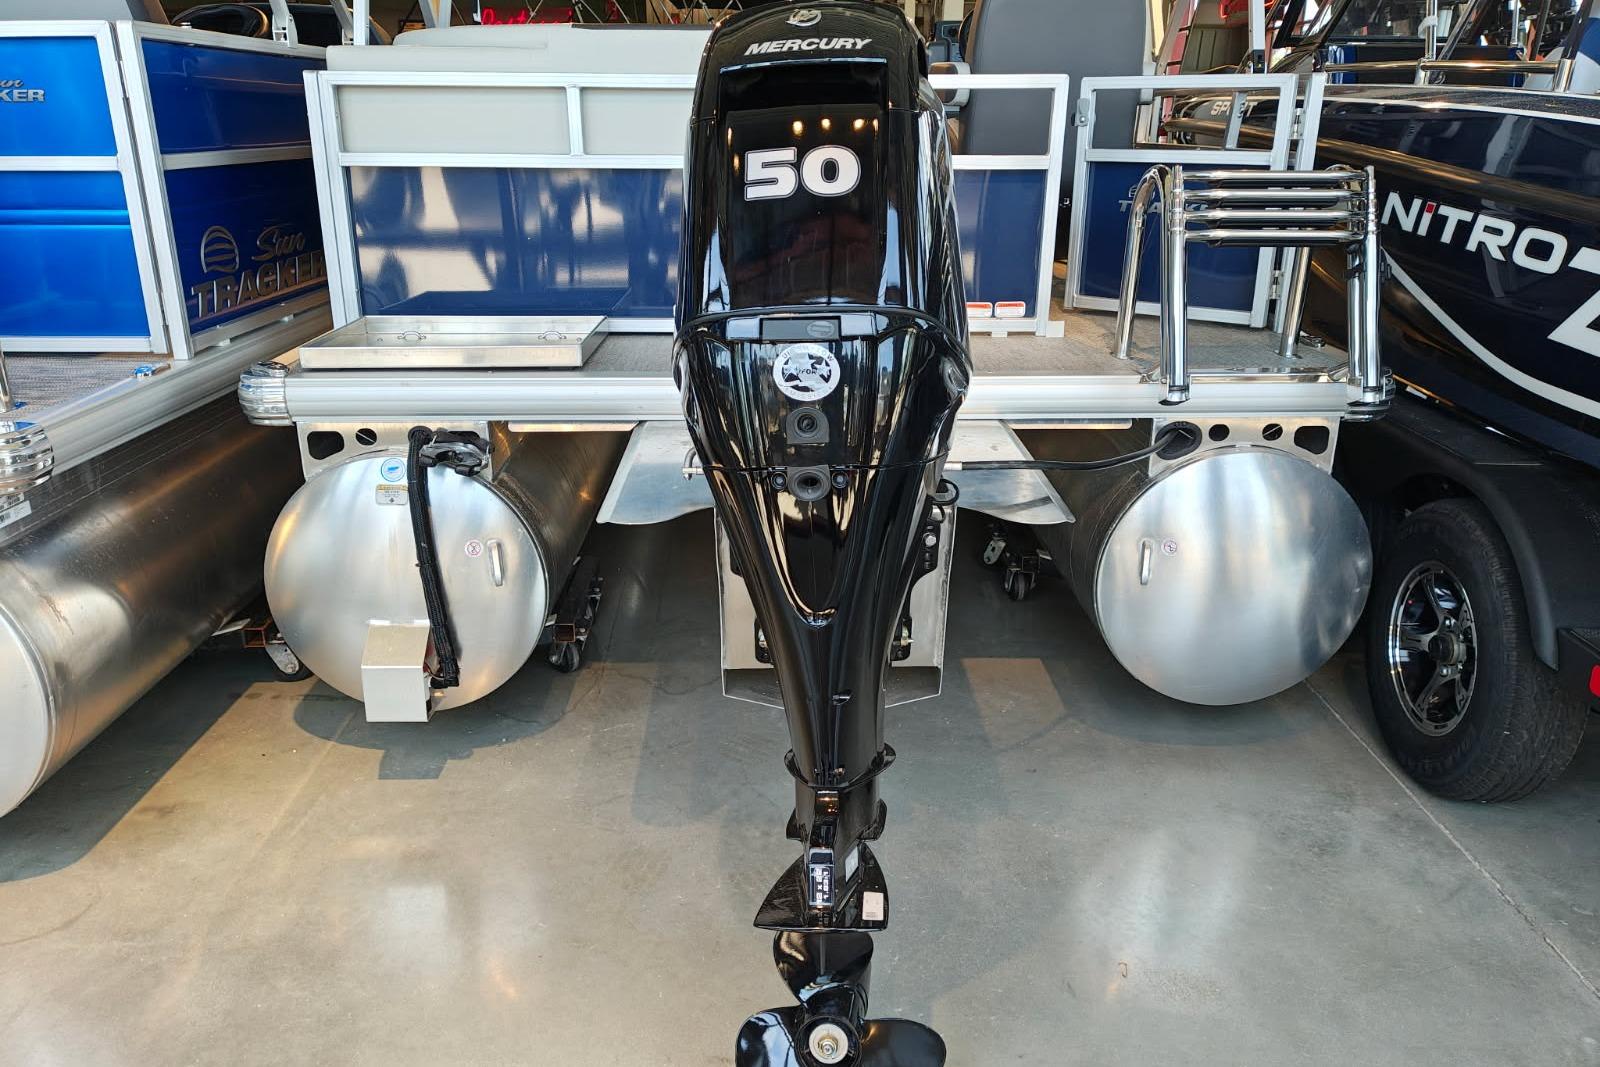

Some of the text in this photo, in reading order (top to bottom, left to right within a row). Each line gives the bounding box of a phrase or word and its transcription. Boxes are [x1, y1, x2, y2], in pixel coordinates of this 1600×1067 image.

[744, 37, 872, 55] MERCURY
[744, 145, 861, 201] 50
[251, 225, 306, 261] Sun
